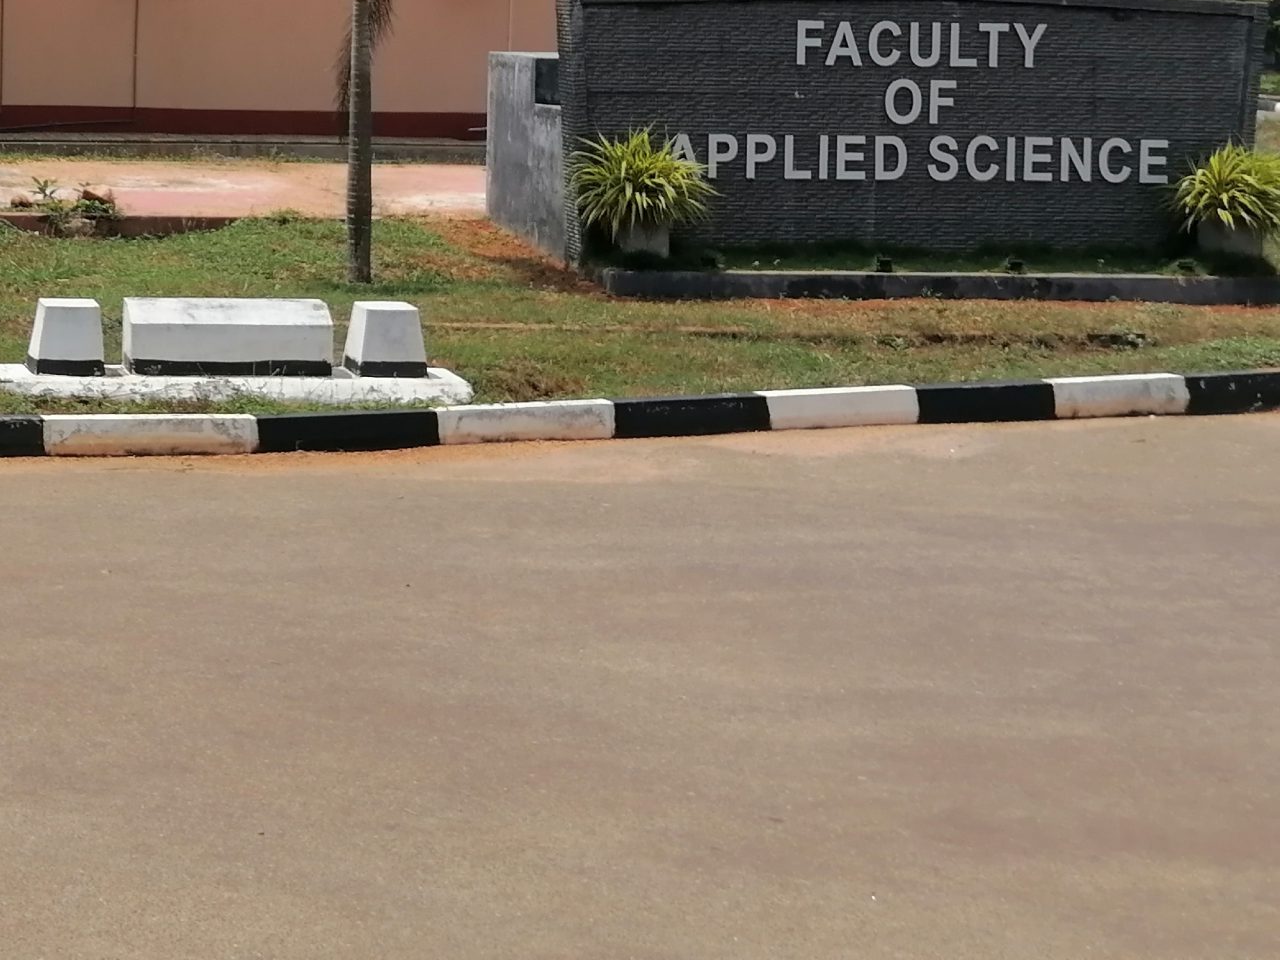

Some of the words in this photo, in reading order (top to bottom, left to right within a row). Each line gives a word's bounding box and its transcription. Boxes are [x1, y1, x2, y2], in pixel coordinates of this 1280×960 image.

[796, 19, 1048, 68] FACULTY
[884, 78, 958, 125] OF
[669, 133, 908, 181] APPLIED
[927, 134, 1169, 184] SCIENCE
